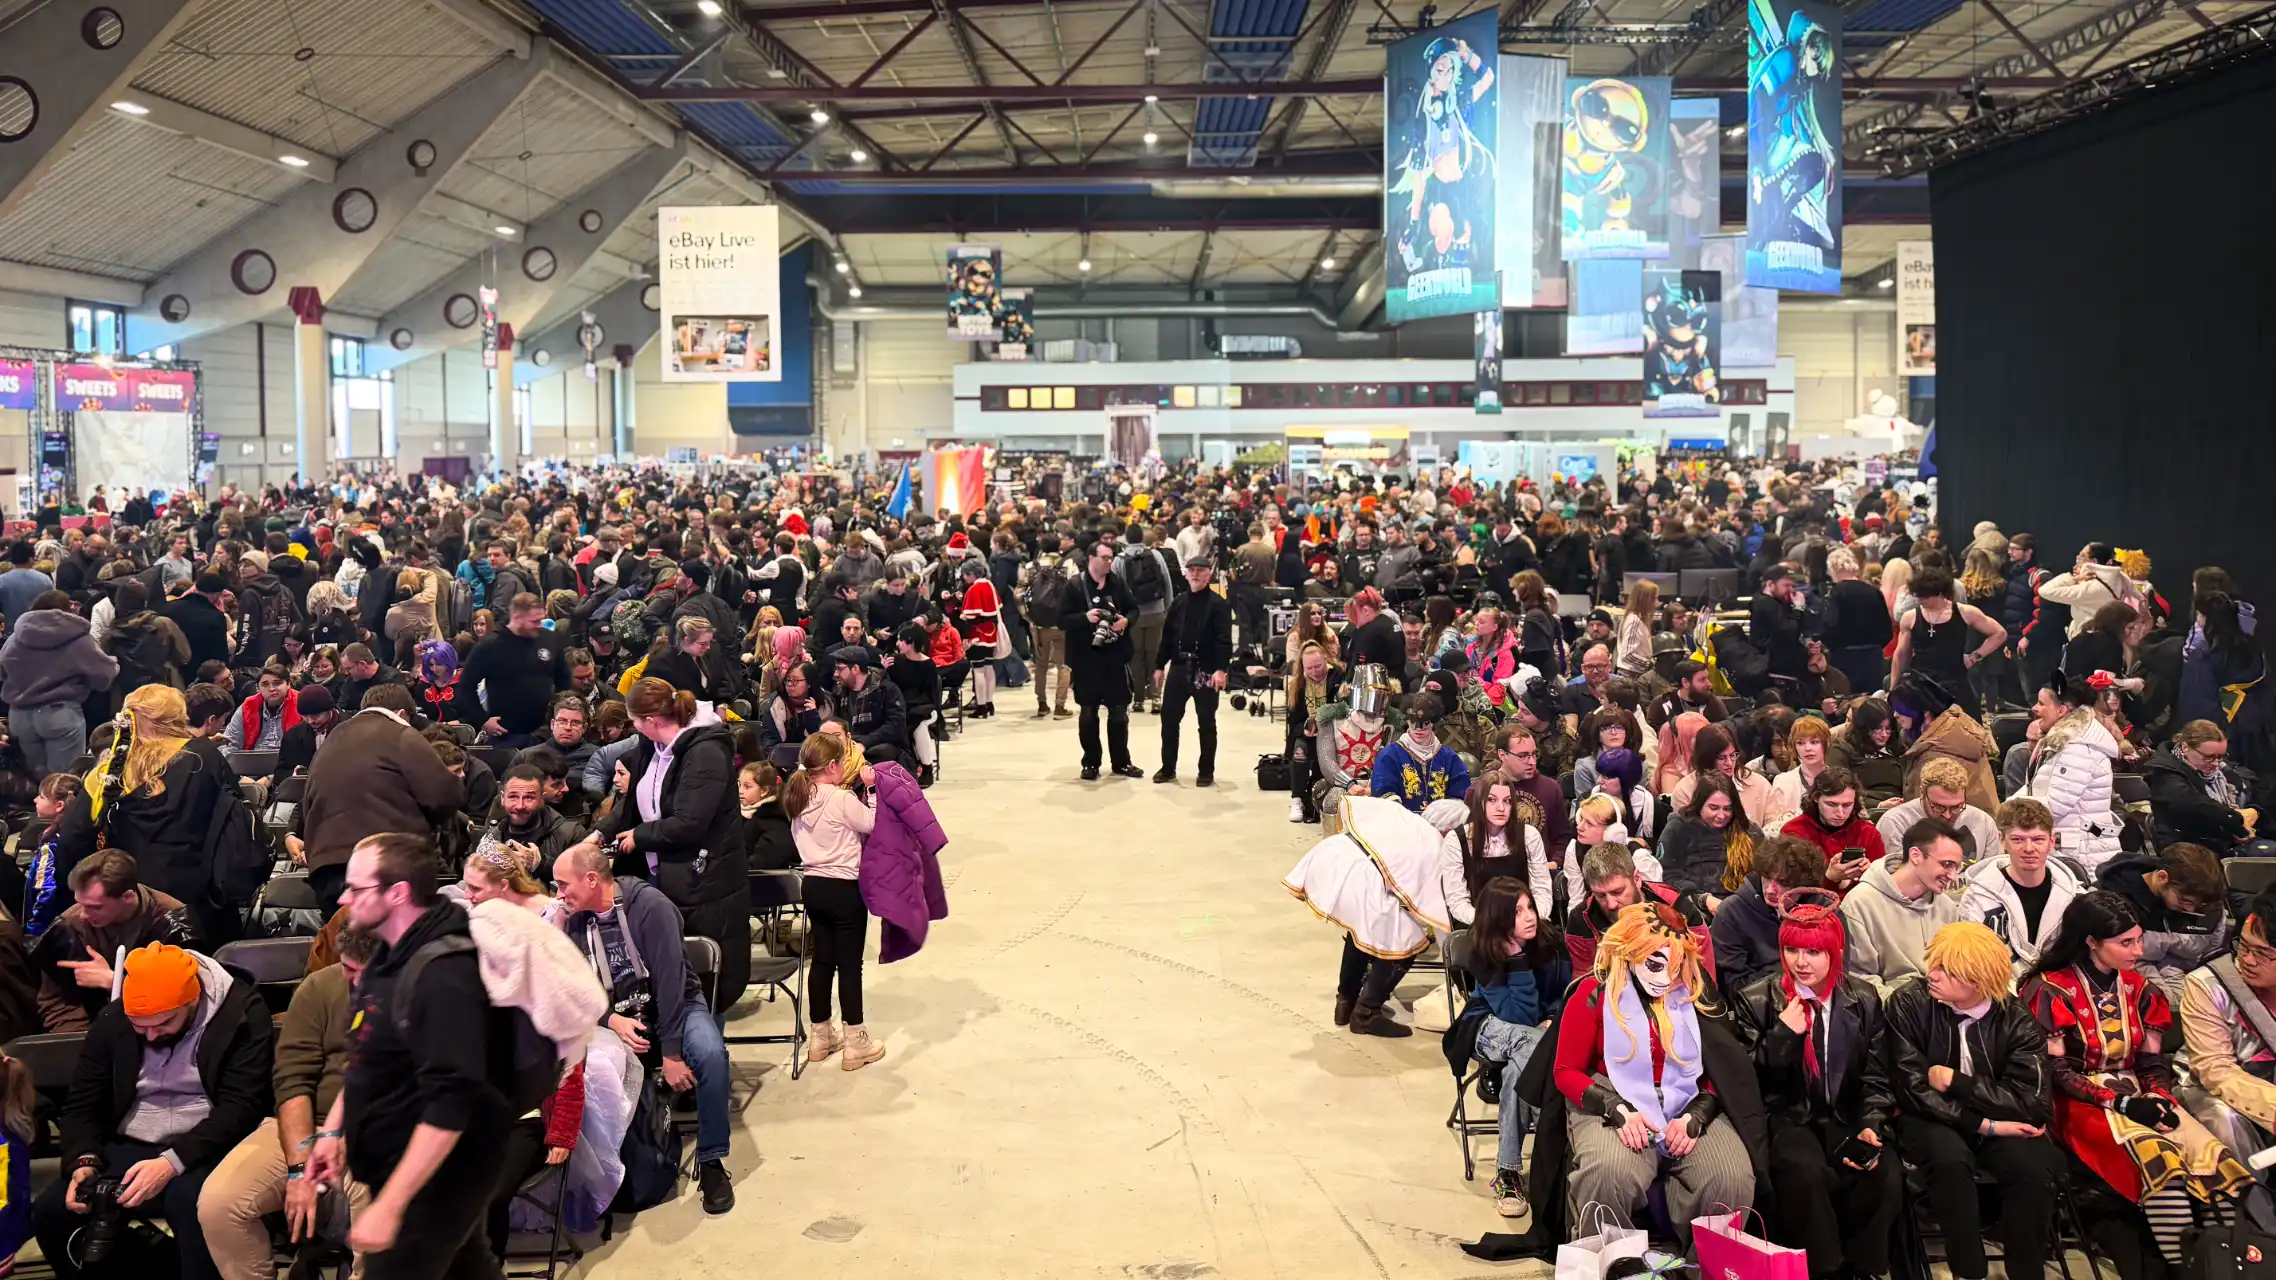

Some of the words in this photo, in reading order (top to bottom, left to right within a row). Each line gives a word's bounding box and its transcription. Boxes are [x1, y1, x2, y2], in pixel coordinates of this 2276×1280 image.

[669, 231, 715, 251] eBay
[720, 231, 755, 247] Live
[669, 253, 690, 270] ist
[695, 253, 734, 270] hier!
[1904, 260, 1933, 274] eBa
[65, 378, 118, 398] SWEETS
[138, 382, 184, 400] SWEETS
